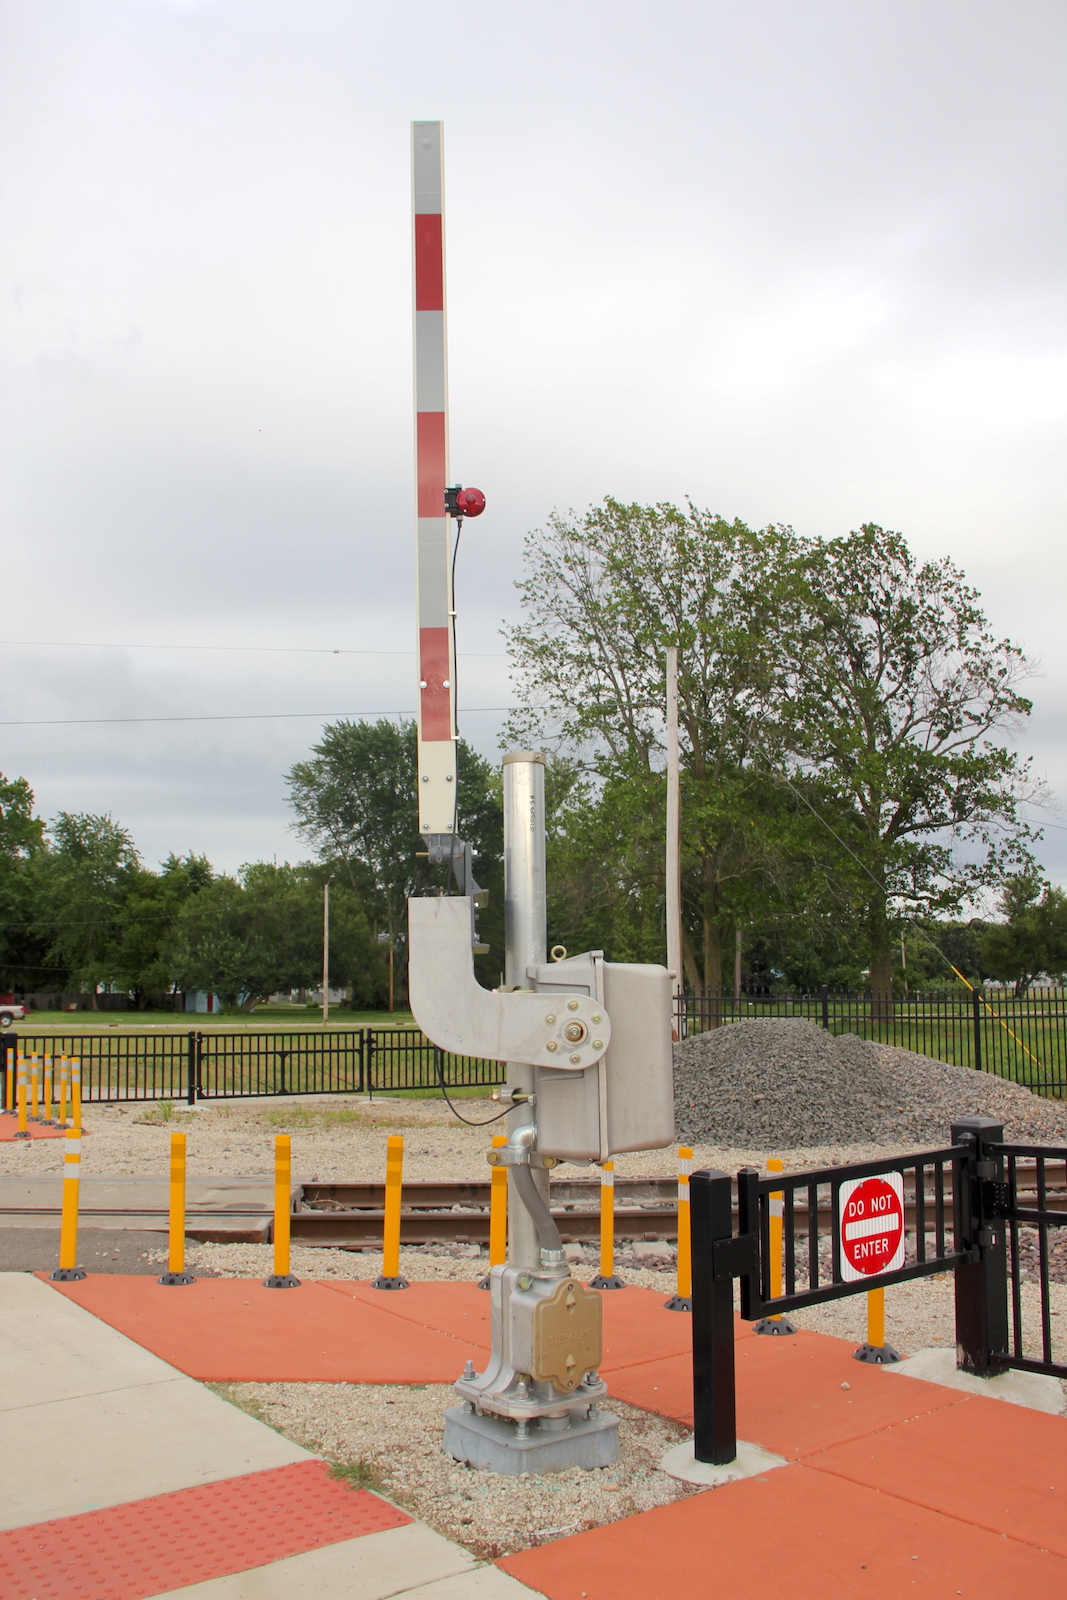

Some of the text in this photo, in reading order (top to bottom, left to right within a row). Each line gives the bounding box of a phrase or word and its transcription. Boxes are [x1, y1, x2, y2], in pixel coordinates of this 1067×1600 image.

[849, 1194, 892, 1217] DO NOT
[853, 1238, 889, 1260] ENTER
[548, 1328, 592, 1346] SIEMENS
